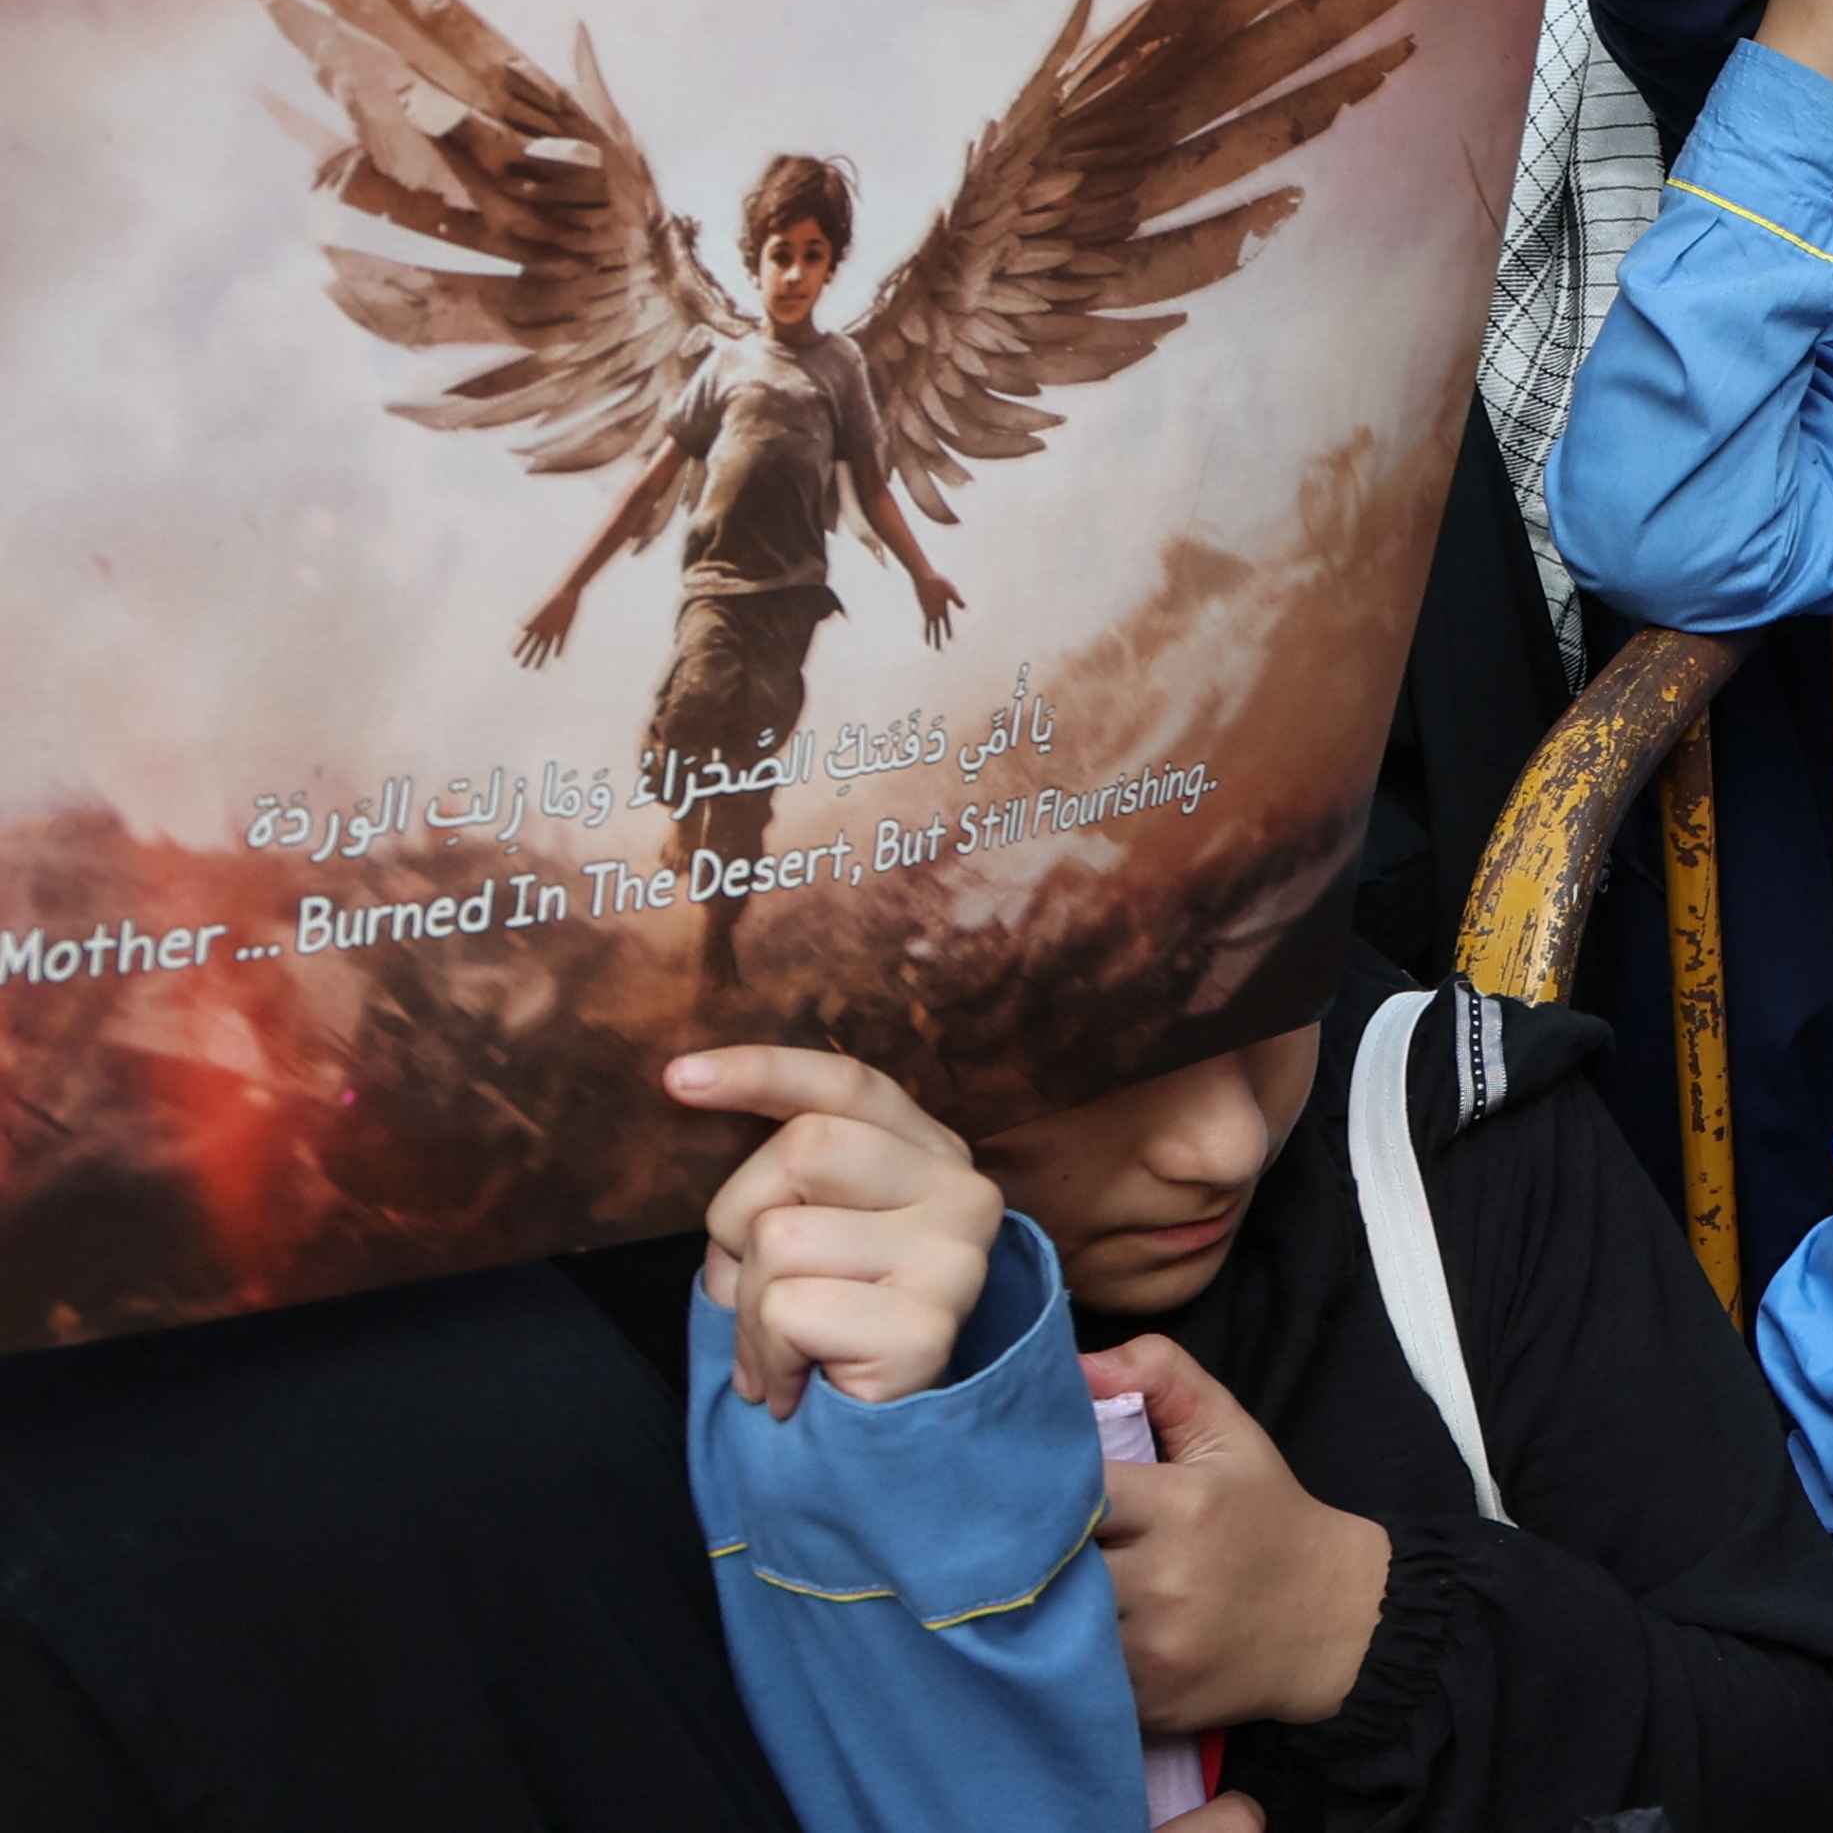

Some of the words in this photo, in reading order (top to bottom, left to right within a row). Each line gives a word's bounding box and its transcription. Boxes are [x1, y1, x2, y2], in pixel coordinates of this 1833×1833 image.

[0, 919, 229, 986] Mother
[295, 878, 496, 955] Burned
[504, 872, 568, 929] In
[581, 860, 676, 919] The
[687, 831, 864, 902] Desert,
[872, 808, 947, 876] But
[955, 794, 1028, 856] Still
[1031, 761, 1219, 837] Flourishing..
